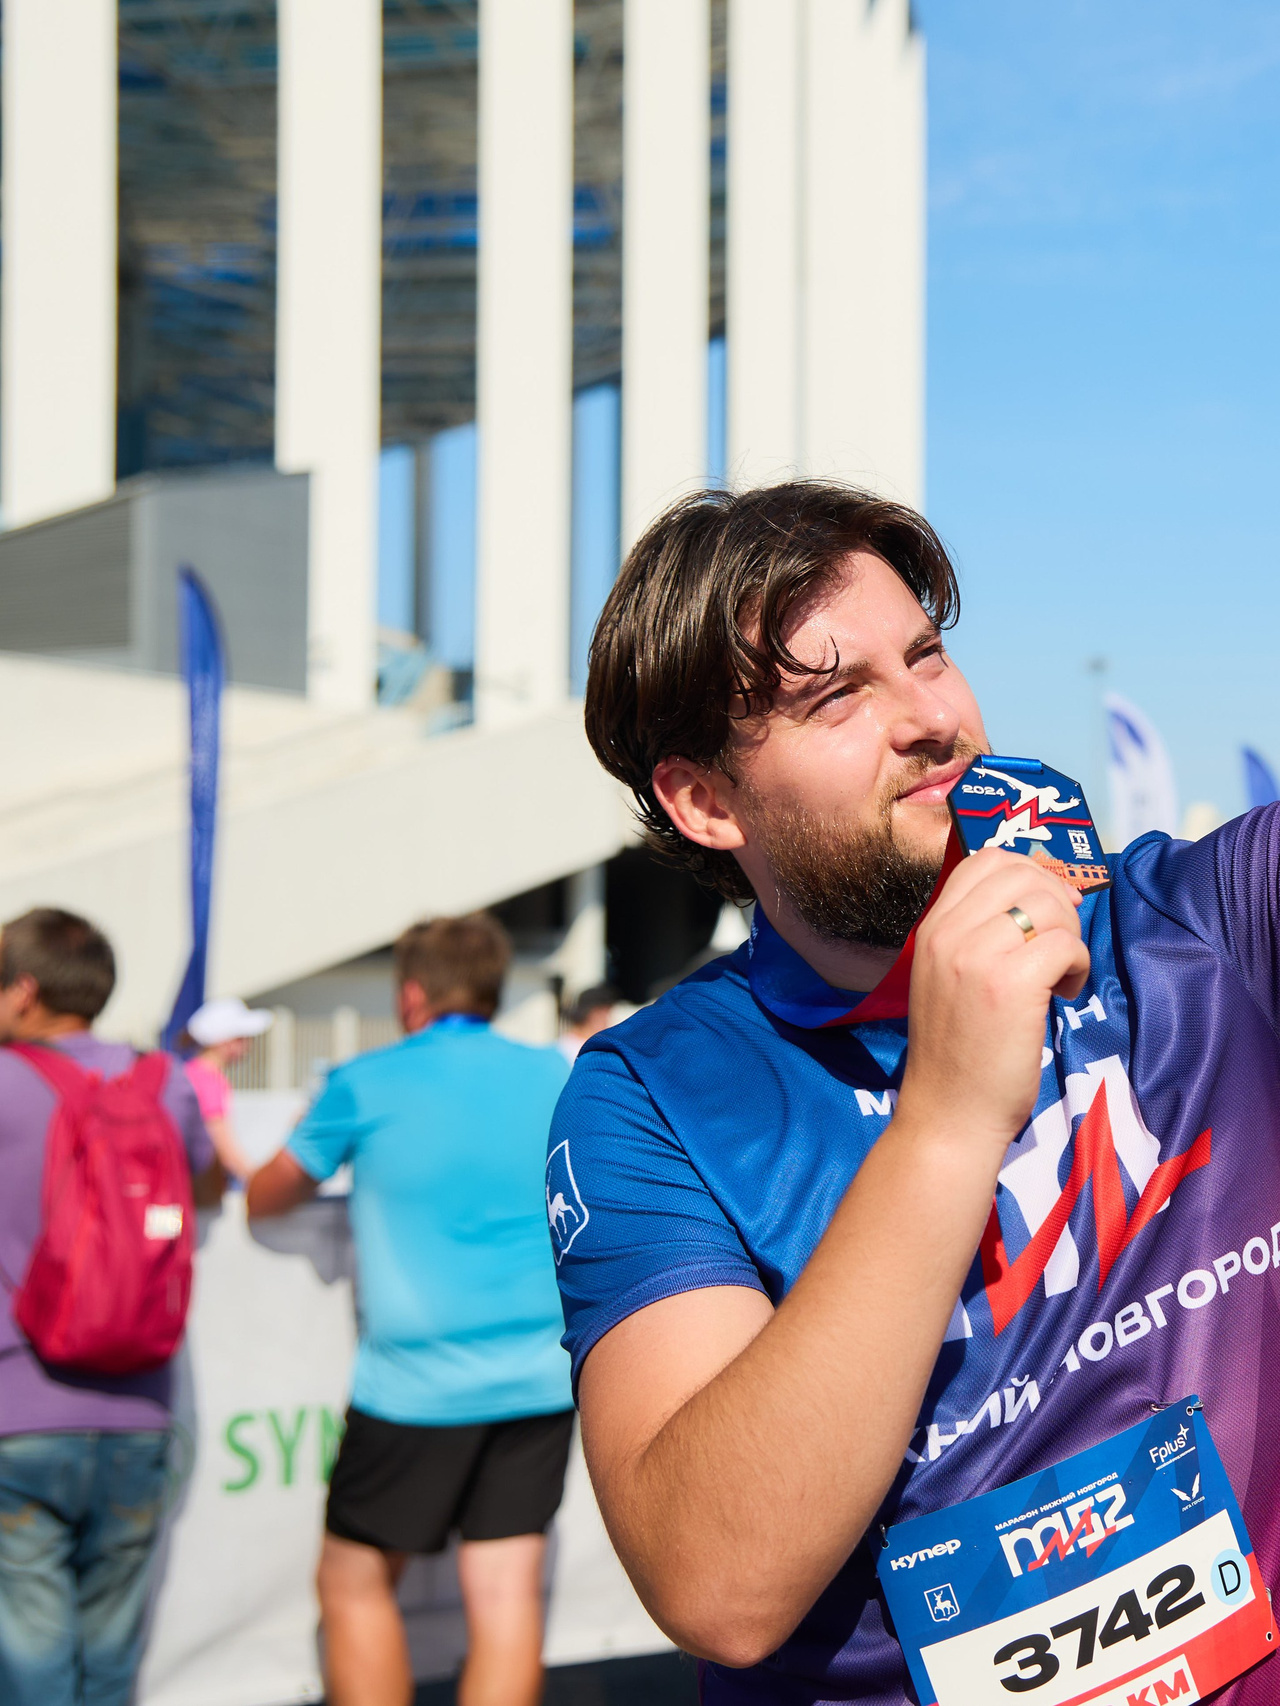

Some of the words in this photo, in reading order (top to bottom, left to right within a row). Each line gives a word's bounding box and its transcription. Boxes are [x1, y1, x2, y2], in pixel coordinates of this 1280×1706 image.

[961, 784, 1006, 797] 2024
[1149, 1436, 1186, 1463] Fplus
[994, 1509, 1039, 1531] МАРАФОН
[1039, 1492, 1076, 1513] НИЖНИЙ
[1076, 1472, 1119, 1496] НОВГОРОД
[890, 1539, 962, 1571] купер
[993, 1564, 1206, 1693] 3742
[1217, 1559, 1242, 1597] D
